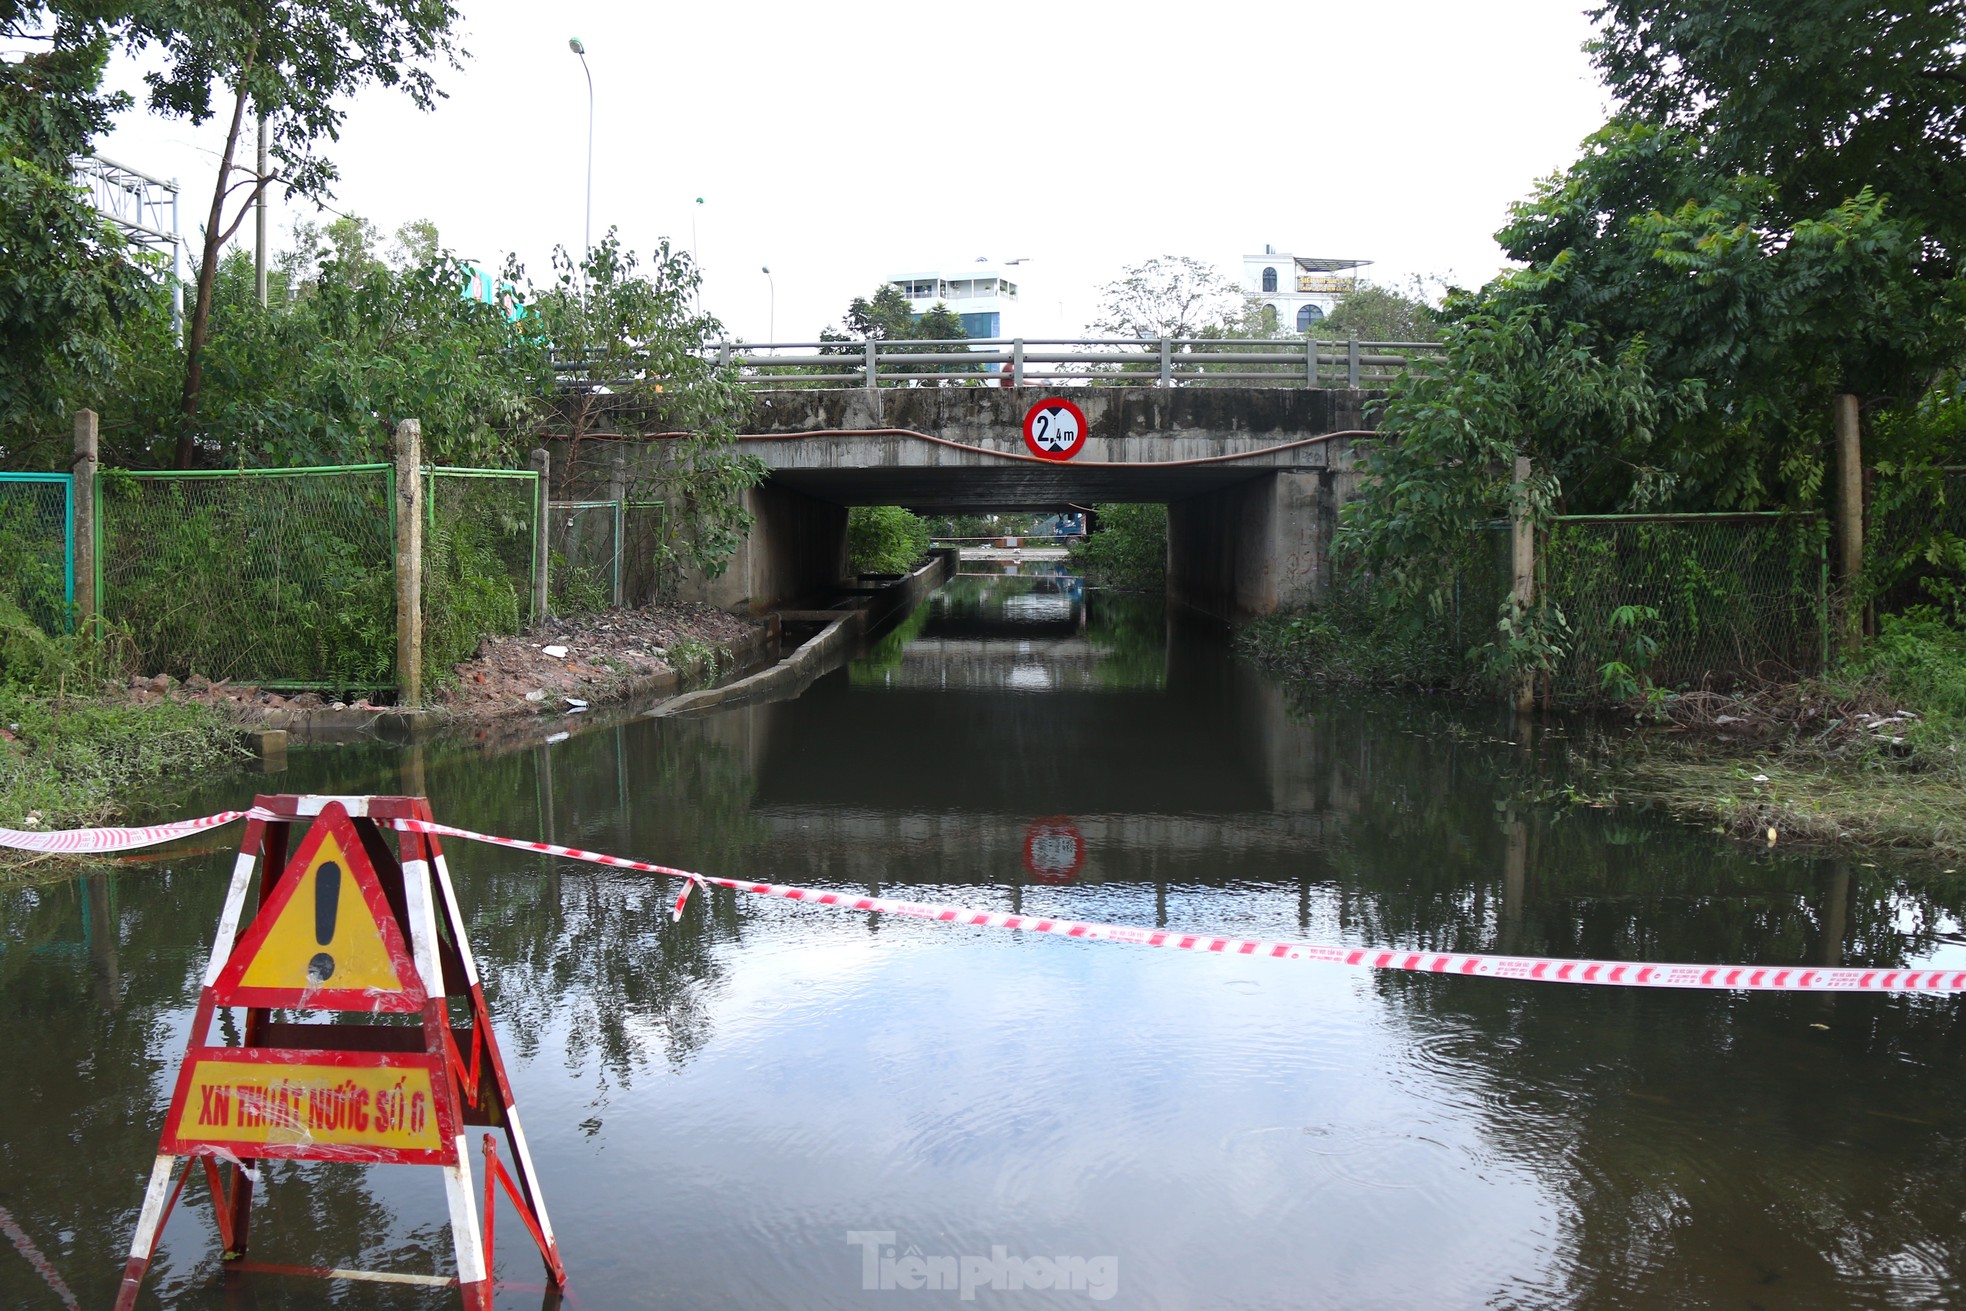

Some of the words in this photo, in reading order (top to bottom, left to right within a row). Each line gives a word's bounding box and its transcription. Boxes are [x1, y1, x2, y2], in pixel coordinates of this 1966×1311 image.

[198, 1084, 231, 1126] XN
[237, 1078, 302, 1129] THOÁT
[308, 1079, 369, 1132] NƯỚC
[375, 1075, 407, 1133] SỐ
